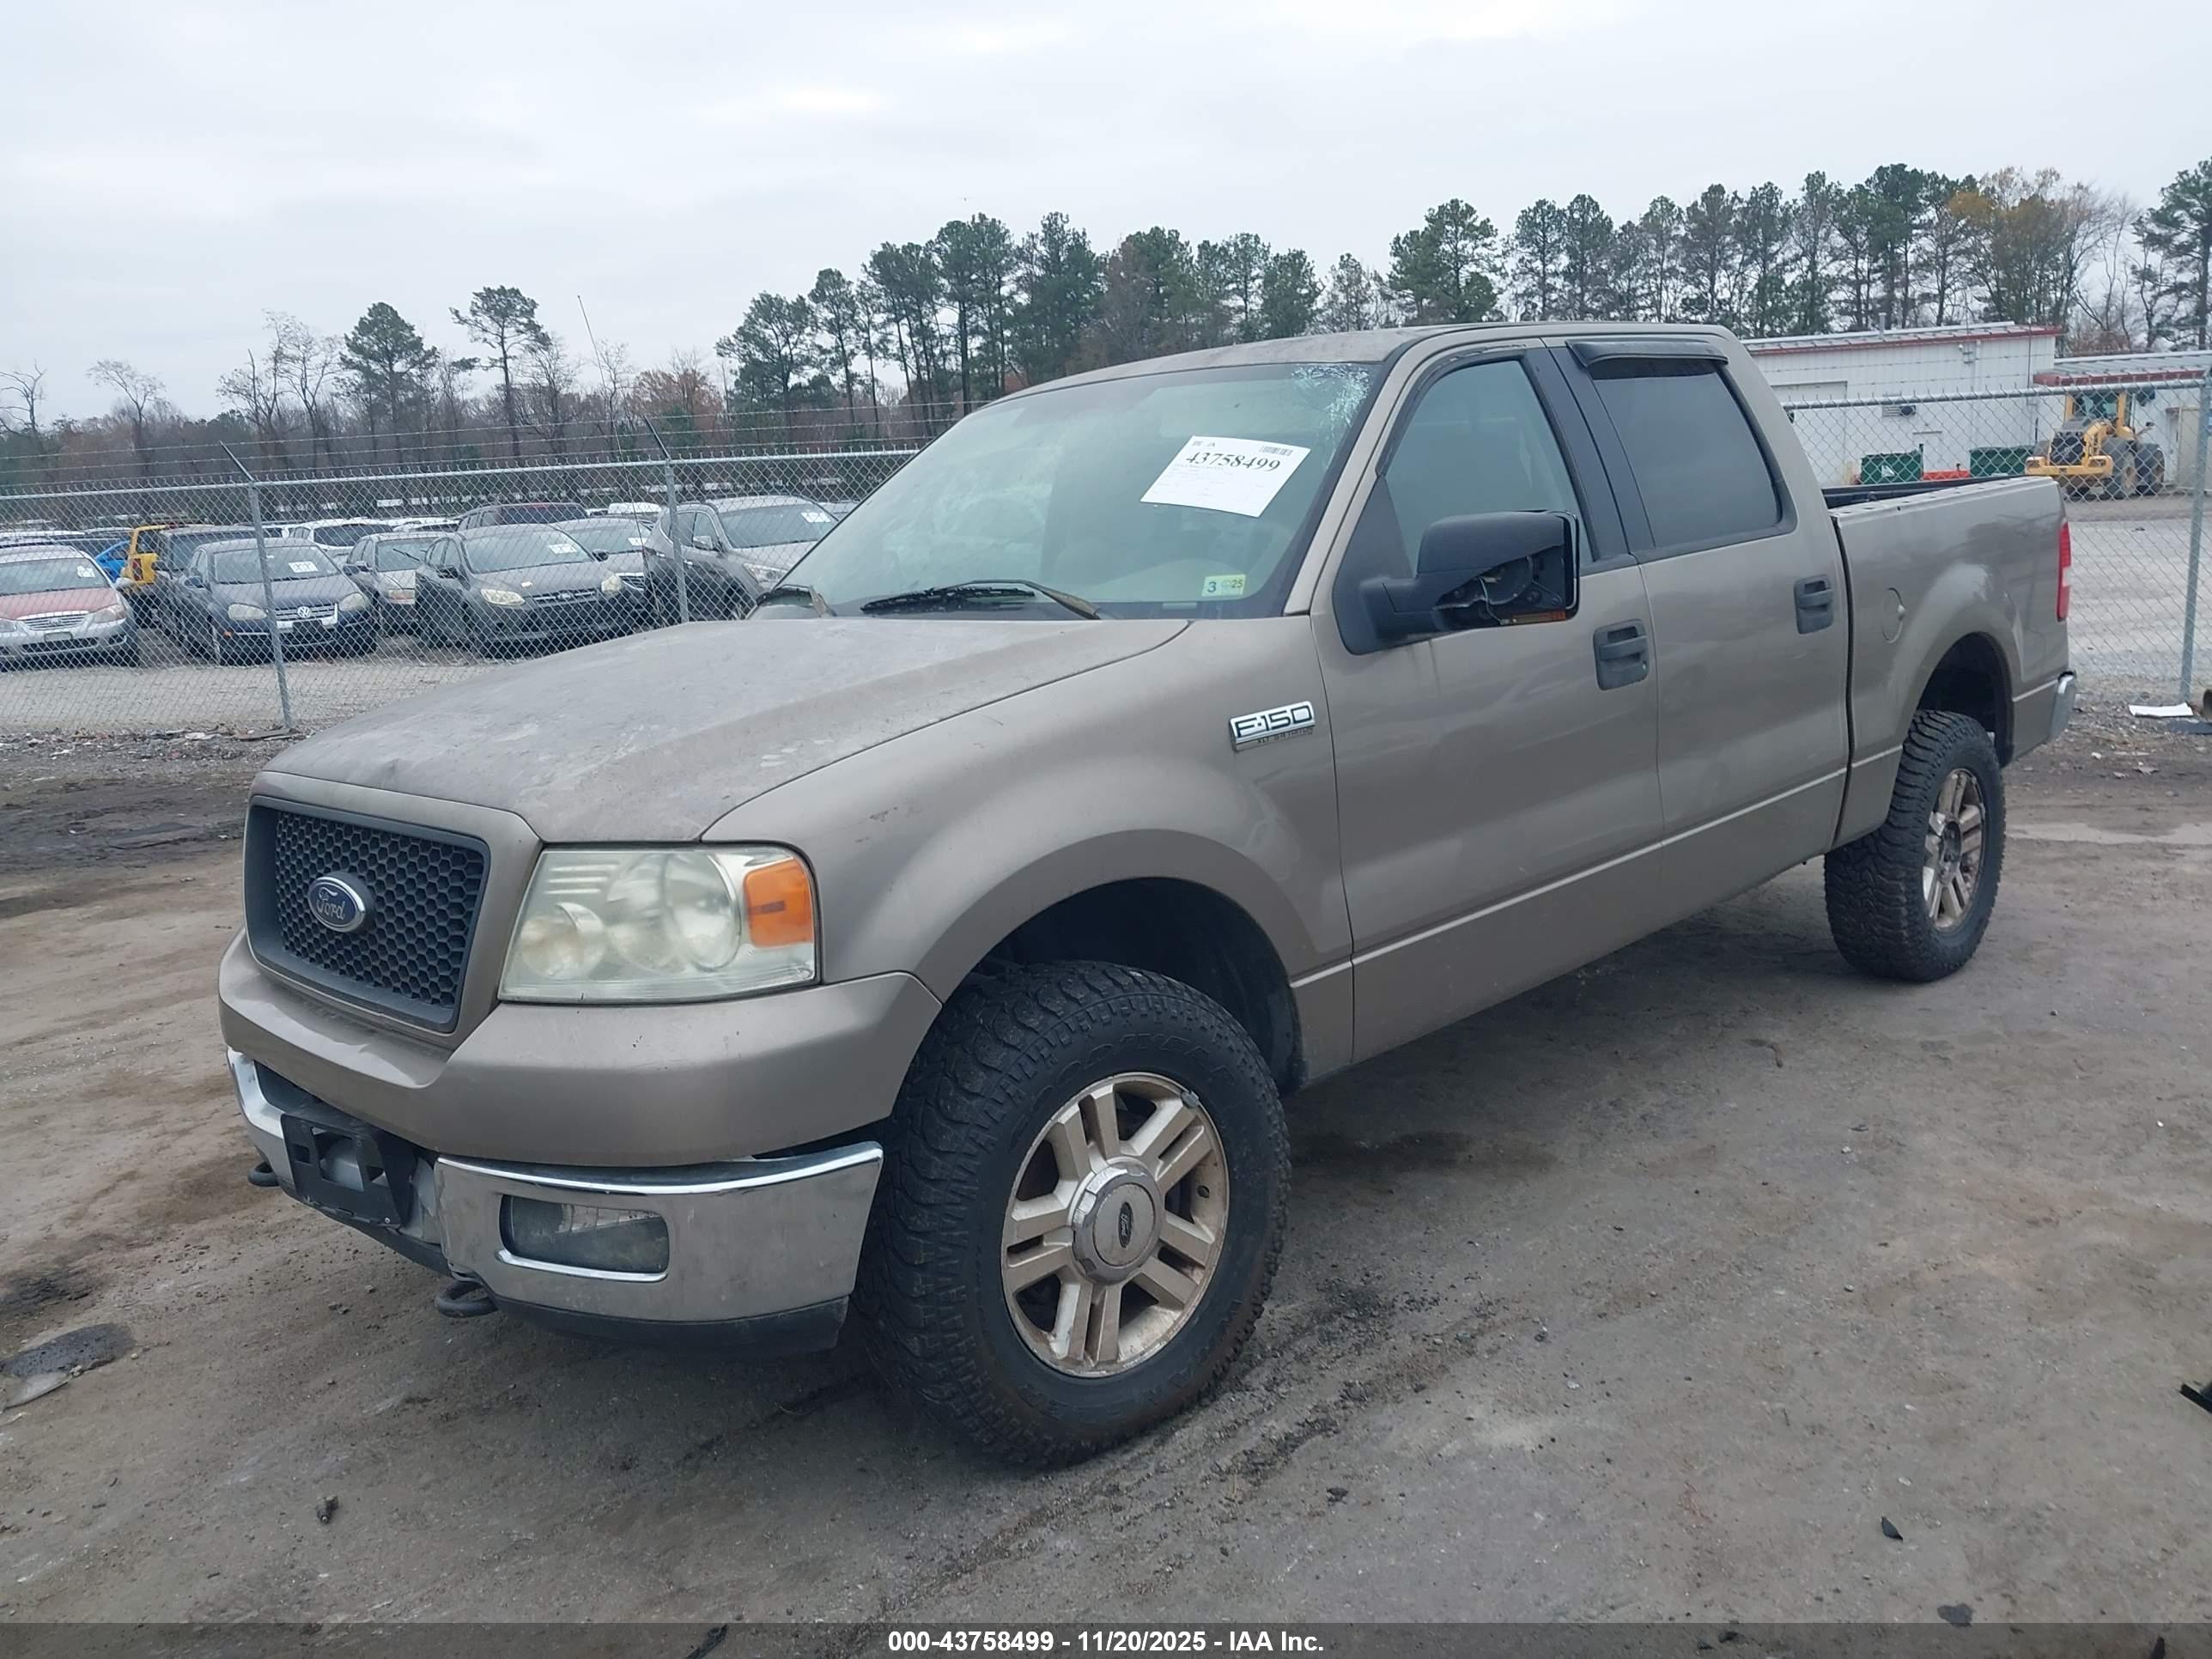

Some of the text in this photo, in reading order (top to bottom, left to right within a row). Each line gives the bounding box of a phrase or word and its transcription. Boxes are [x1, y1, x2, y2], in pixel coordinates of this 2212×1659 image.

[1185, 452, 1281, 471] 43758499
[1207, 579, 1244, 593] 3 25
[316, 886, 347, 921] Ford
